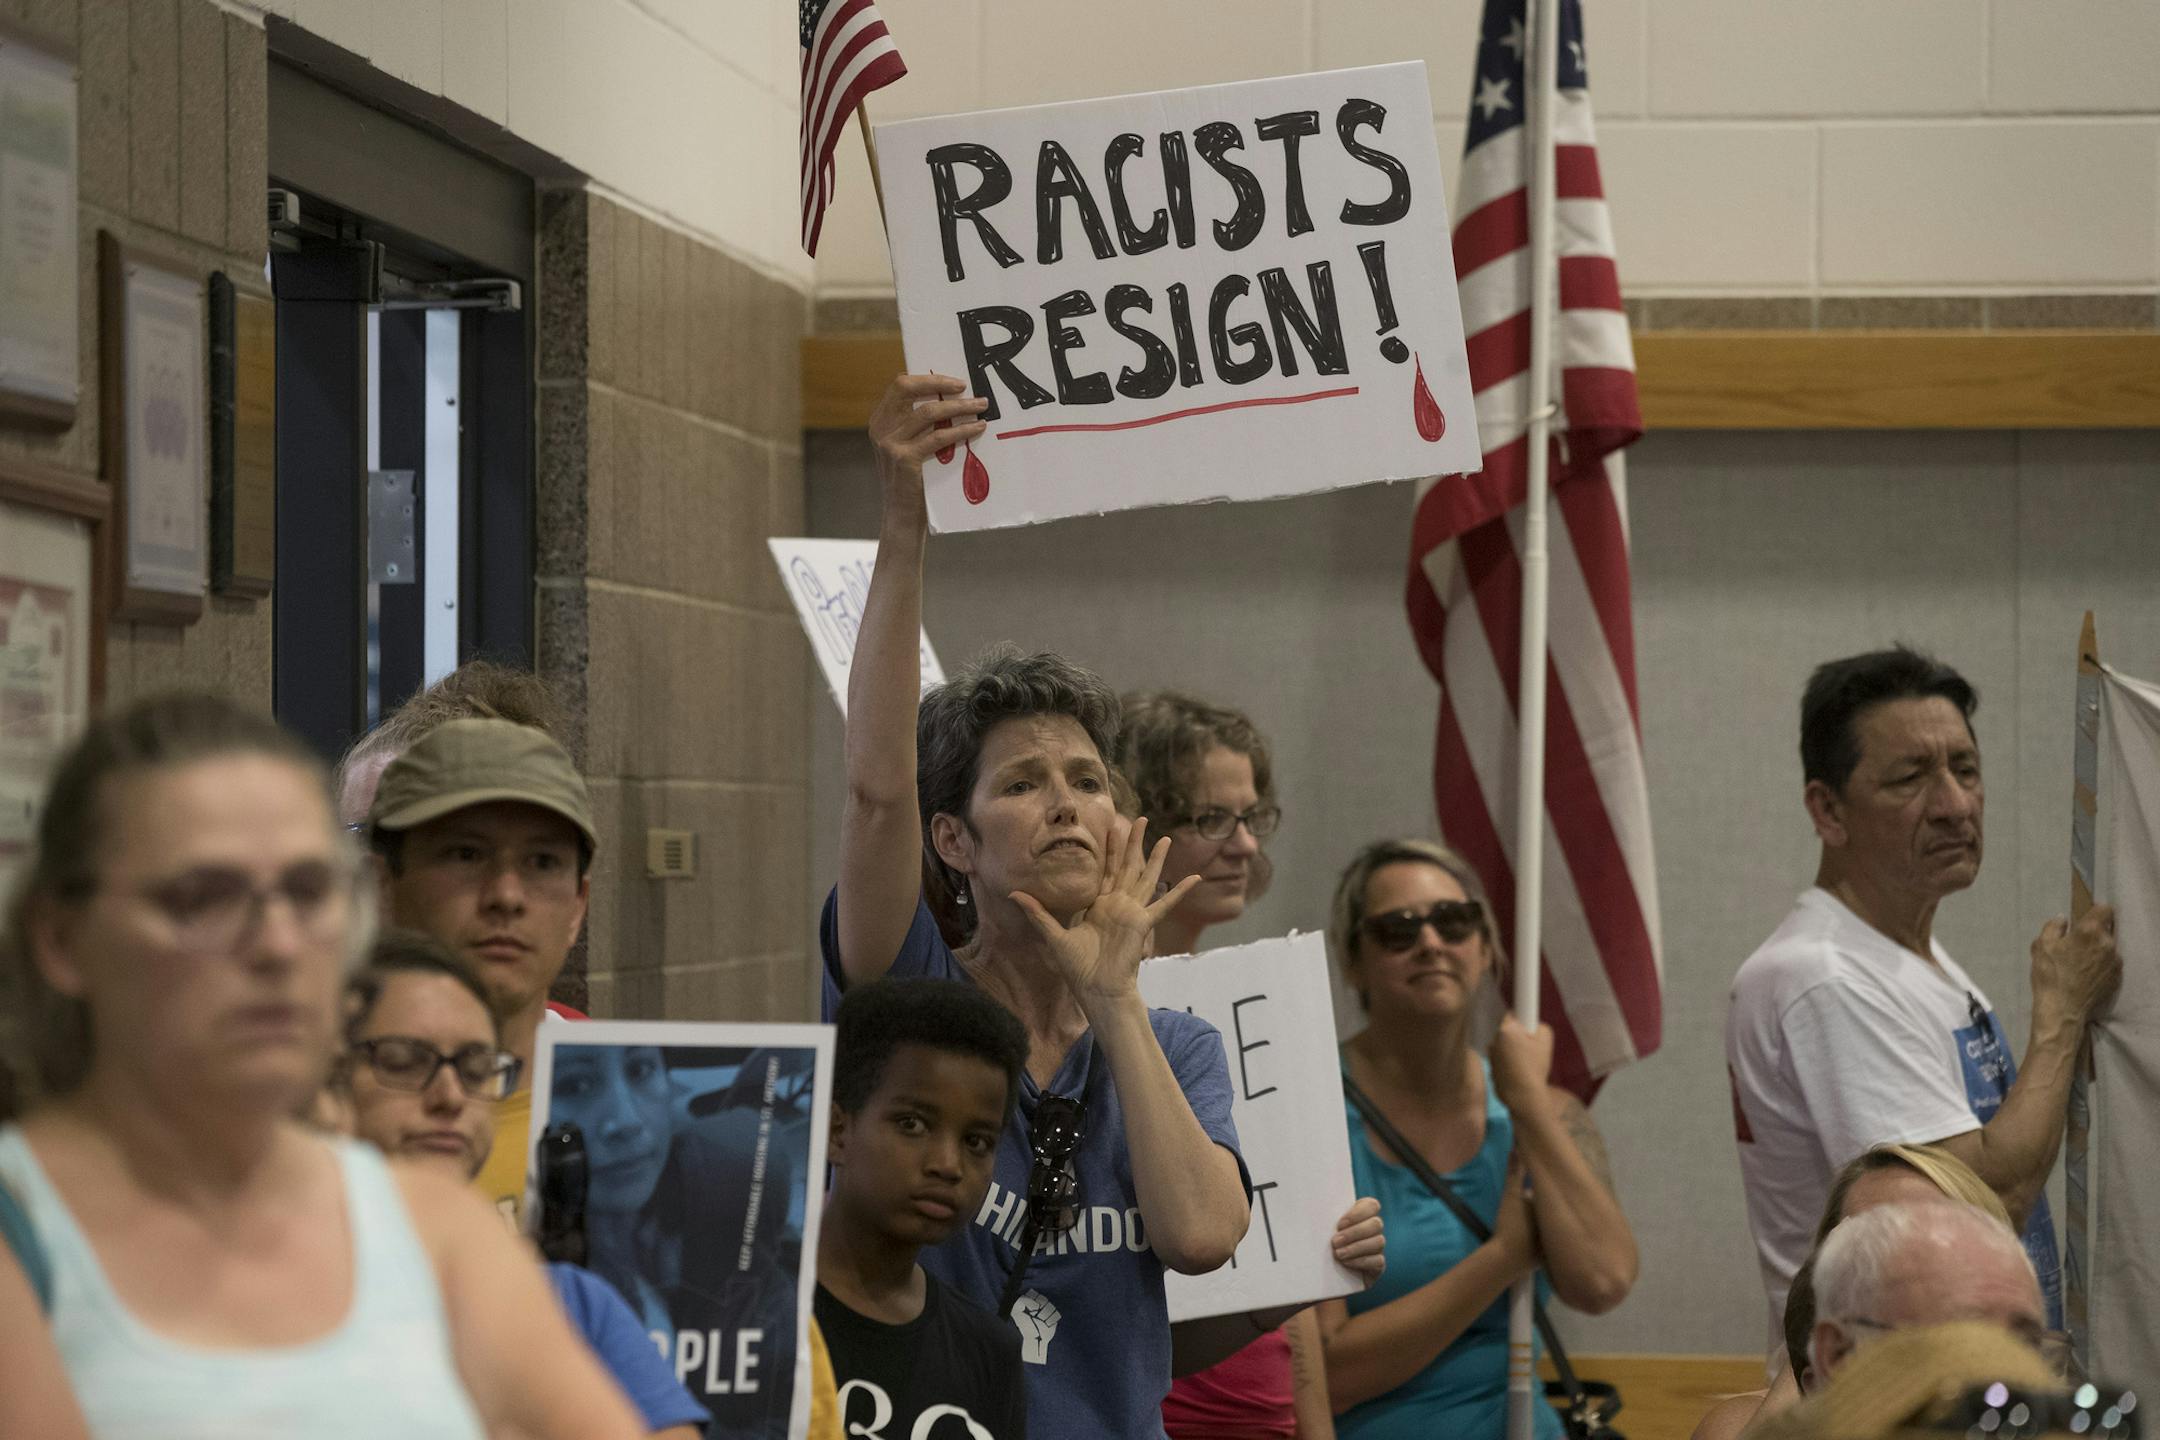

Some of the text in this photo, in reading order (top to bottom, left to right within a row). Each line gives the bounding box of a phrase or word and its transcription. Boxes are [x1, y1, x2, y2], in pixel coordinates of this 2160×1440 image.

[925, 98, 1412, 283] RACISTS
[956, 240, 1410, 421] RESIGN!
[975, 1182, 1151, 1256] HILANDO
